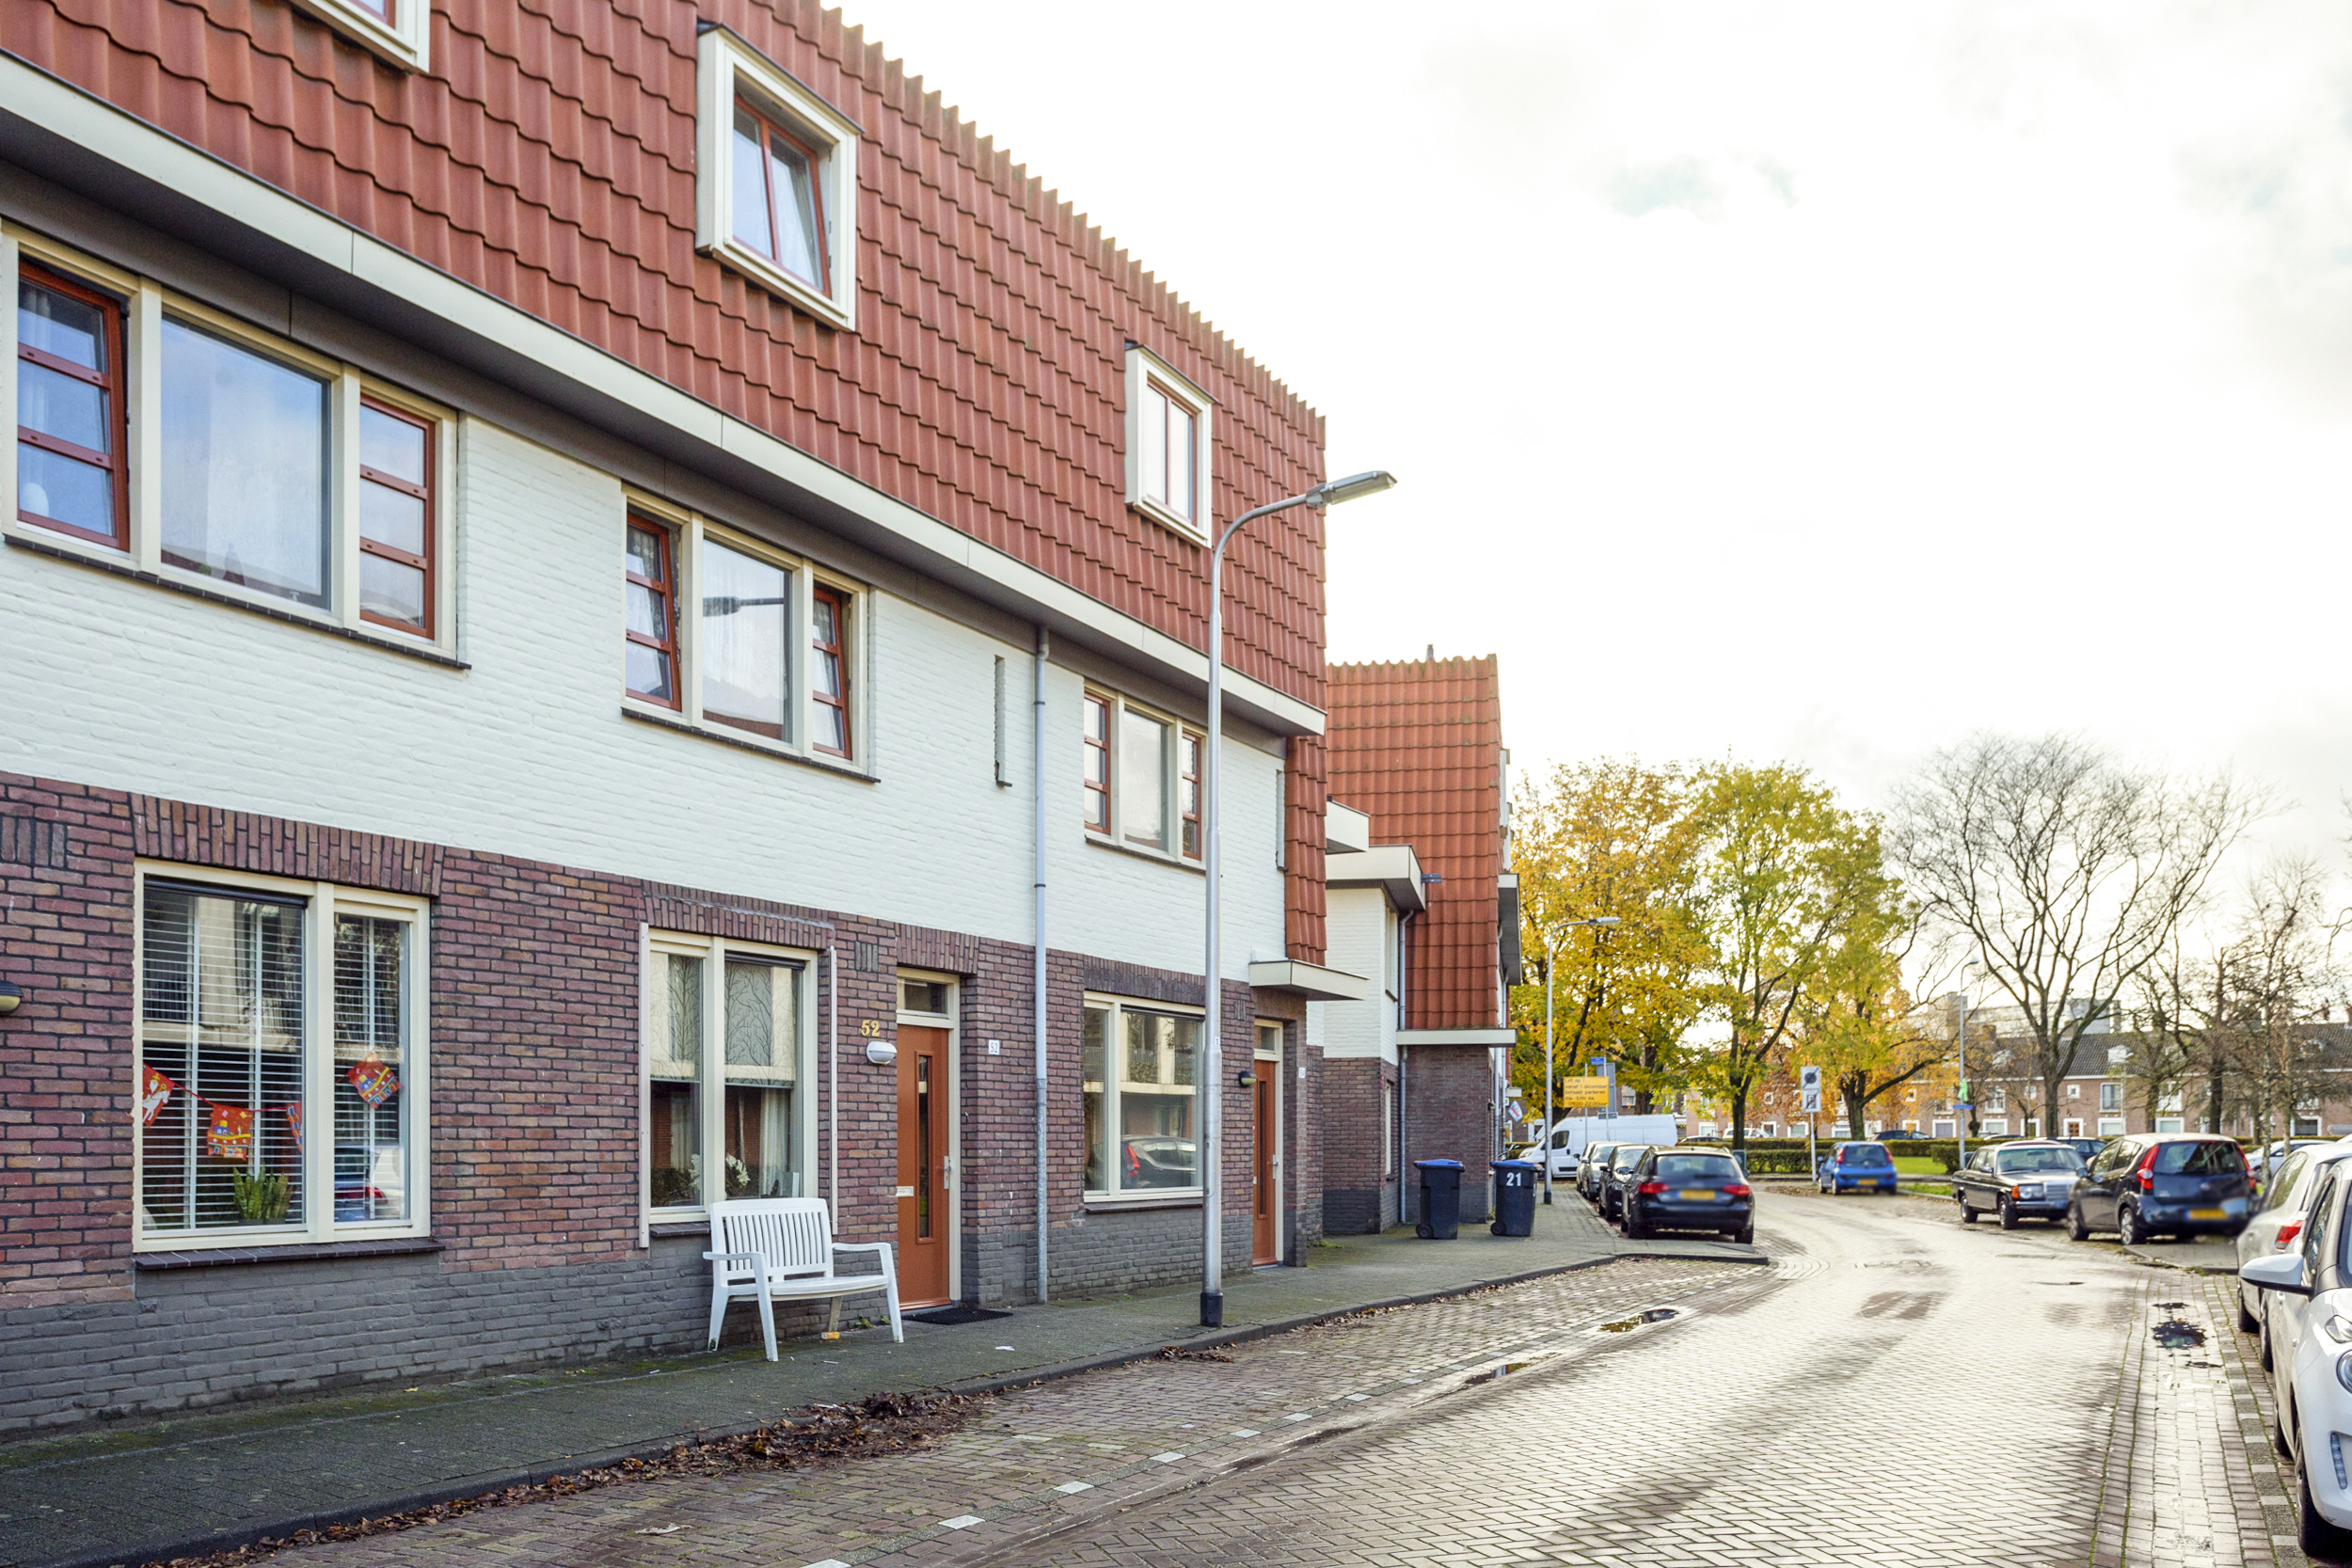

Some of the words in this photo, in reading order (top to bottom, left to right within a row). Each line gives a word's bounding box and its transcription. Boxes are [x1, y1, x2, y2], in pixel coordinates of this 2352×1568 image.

[862, 1020, 880, 1037] 52
[991, 1041, 998, 1053] 52
[1506, 1172, 1522, 1187] 21
